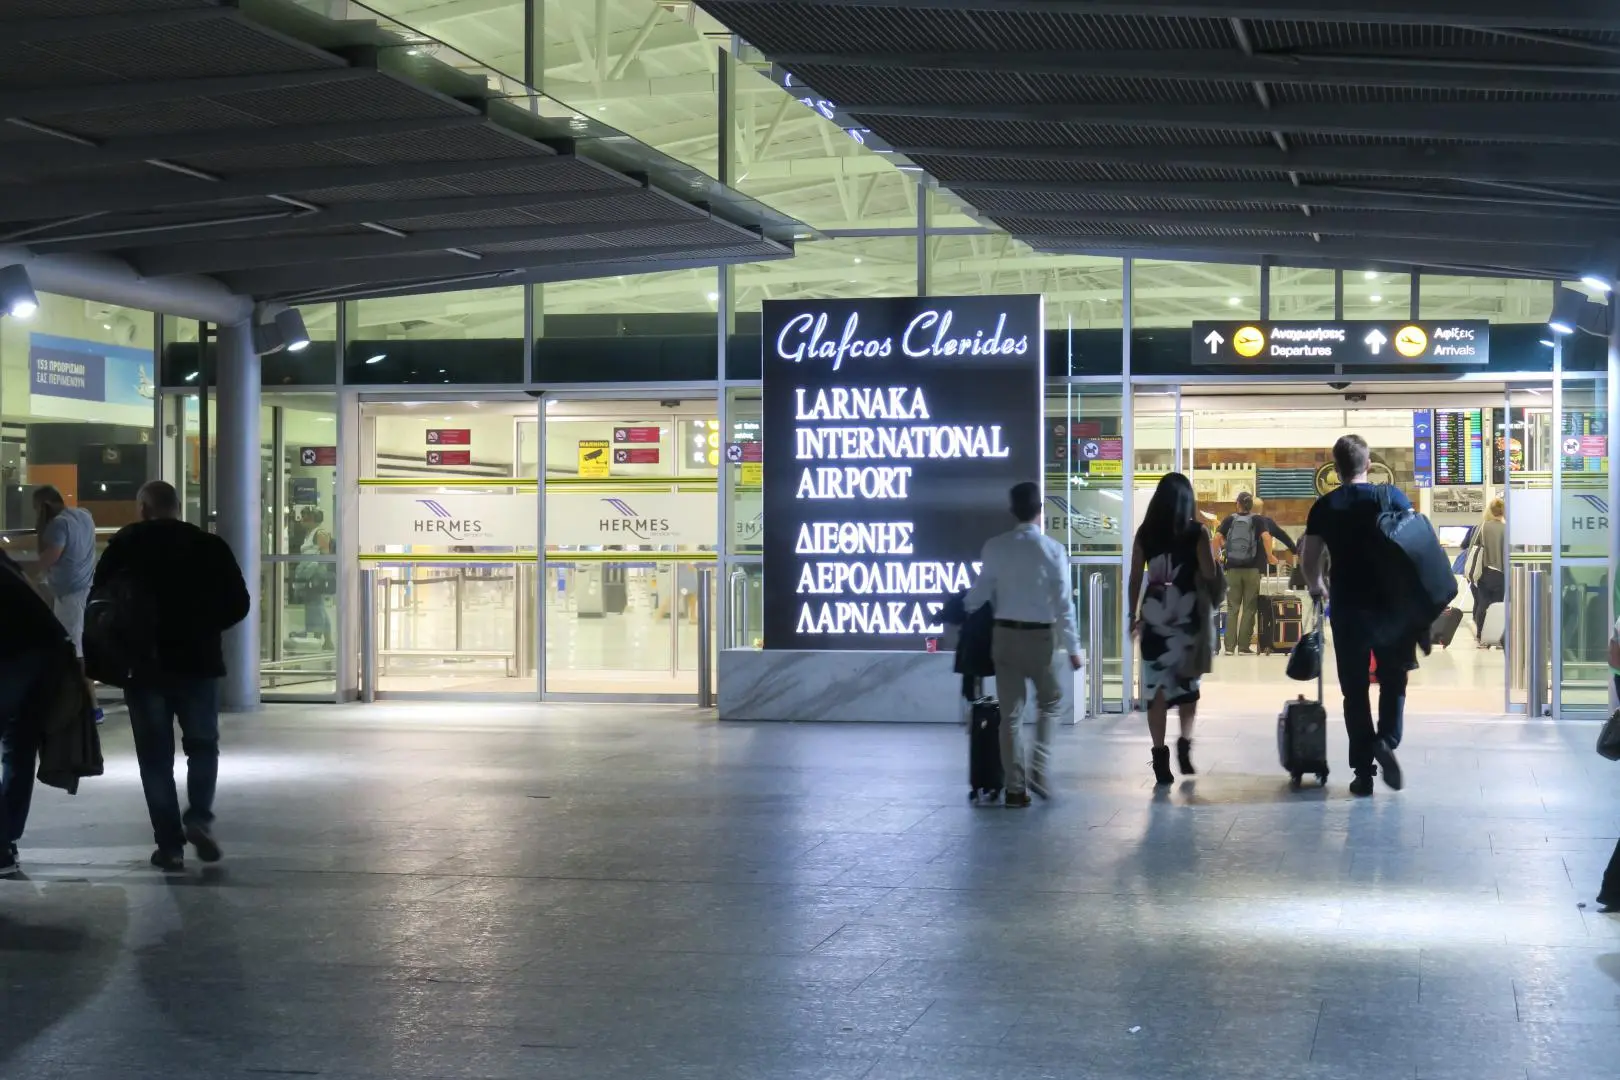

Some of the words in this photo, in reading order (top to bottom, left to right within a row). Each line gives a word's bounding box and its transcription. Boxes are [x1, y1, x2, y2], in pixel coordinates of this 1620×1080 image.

[777, 312, 892, 371] Glafcos
[902, 310, 1028, 358] Clerides
[1433, 327, 1475, 341] Αφίξεις
[1270, 345, 1332, 358] Departures
[1433, 344, 1476, 356] Arrivals
[795, 387, 930, 420] LARNAKA
[795, 425, 1009, 459] INTERNATIONAL
[796, 467, 912, 498] AIRPORT
[414, 519, 482, 539] HERMES
[599, 518, 669, 538] HERMES
[795, 522, 914, 554] ΔΙΕΘΝΗΣ
[796, 602, 944, 634] ΛΑΡΝΑΚΑΣ
